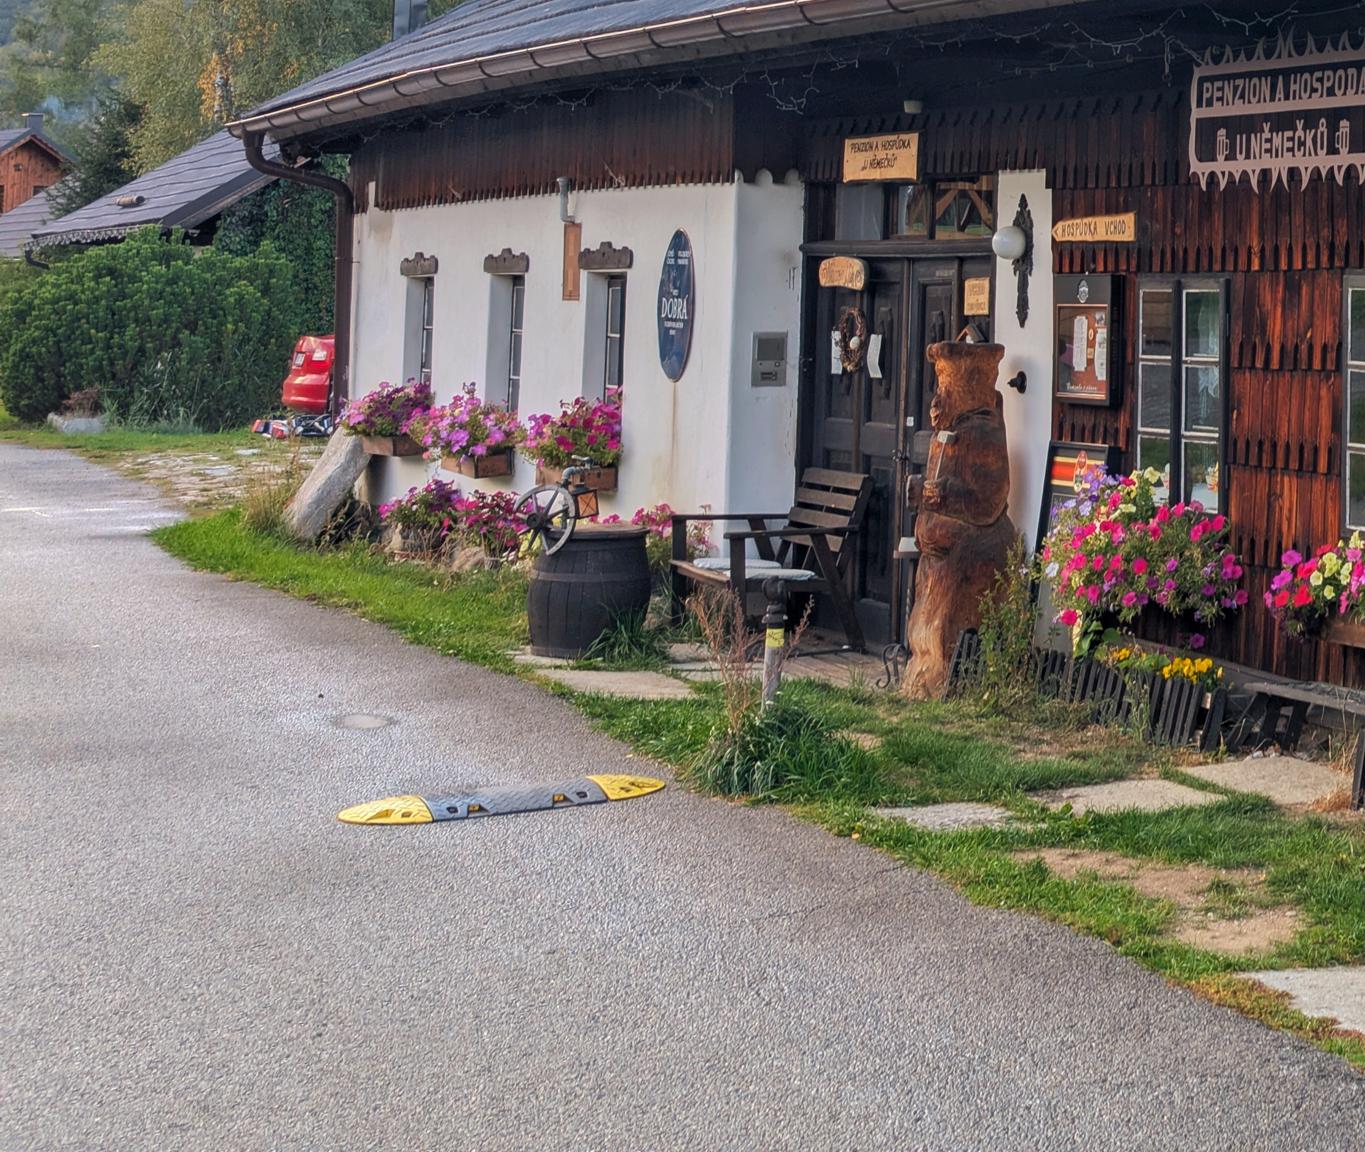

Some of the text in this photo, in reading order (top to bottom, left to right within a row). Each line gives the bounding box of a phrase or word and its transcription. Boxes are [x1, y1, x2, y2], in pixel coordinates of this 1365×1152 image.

[1202, 76, 1270, 108] PENZION
[1276, 76, 1285, 102] A
[850, 140, 874, 154] PENZION
[1236, 118, 1328, 161] U NĚMEČKŮ
[1104, 219, 1127, 236] VCHOD
[661, 294, 689, 319] DOBRÁ
